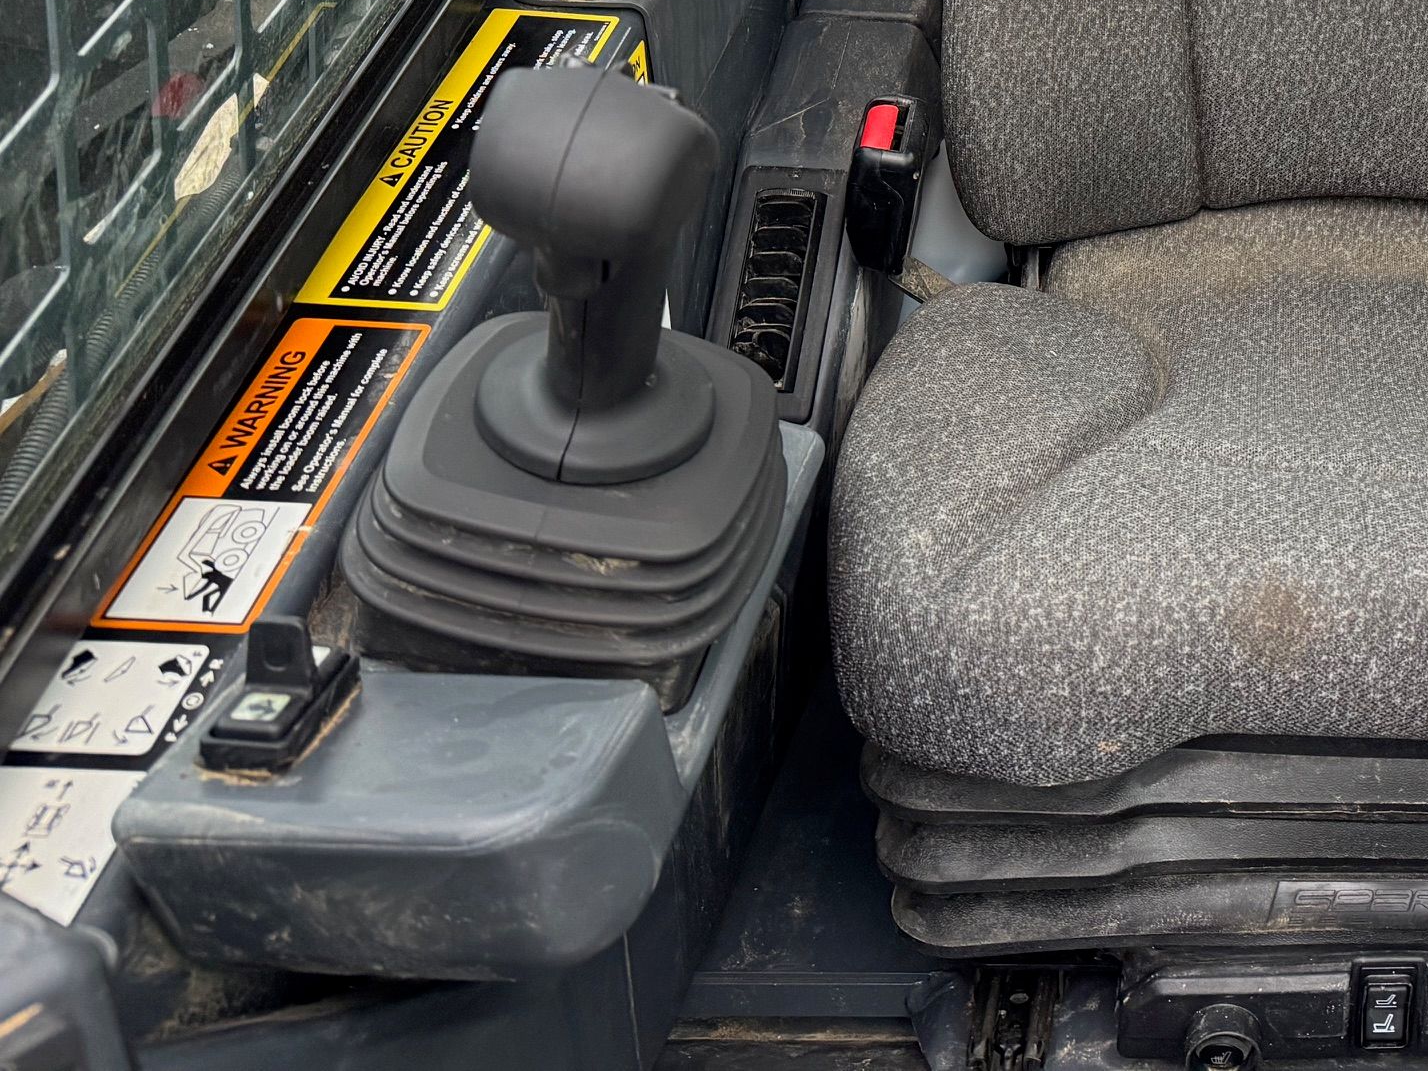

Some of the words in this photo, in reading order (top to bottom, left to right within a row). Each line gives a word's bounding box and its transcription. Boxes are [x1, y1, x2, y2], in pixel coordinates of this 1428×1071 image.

[390, 99, 454, 169] CAUTION
[455, 108, 472, 124] Keep
[467, 85, 487, 108] children
[482, 74, 495, 86] and
[490, 57, 506, 75] others
[347, 261, 369, 286] AVOID
[362, 235, 386, 262] INJURY
[383, 214, 401, 231] Read
[397, 201, 410, 214] and
[406, 165, 434, 201] understand
[359, 249, 389, 286] Operator's
[382, 225, 406, 250] Manual
[399, 203, 420, 225] before
[416, 173, 442, 204] operating
[434, 161, 448, 173] this
[373, 255, 399, 287] machine.
[392, 267, 412, 288] Know
[405, 239, 430, 268] location
[425, 225, 439, 240] and
[432, 198, 456, 226] function
[451, 190, 460, 199] of
[413, 270, 433, 289] Keep
[427, 248, 447, 270] safety
[440, 222, 462, 249] devices
[434, 271, 453, 290] Keep
[448, 244, 470, 271] screens
[465, 230, 478, 244] and
[220, 349, 307, 450] WARNING
[240, 452, 268, 490] Always
[261, 425, 286, 458] install
[278, 406, 301, 430] boom
[294, 387, 313, 409] lock
[306, 359, 332, 390] before
[255, 449, 285, 491] working
[279, 440, 293, 455] on
[287, 429, 299, 441] or
[294, 399, 320, 430] around
[312, 383, 330, 401] this
[325, 347, 352, 385] machine
[347, 331, 363, 350] with
[269, 476, 286, 492] the
[280, 446, 304, 479] loader
[297, 422, 320, 448] boom
[316, 392, 339, 423] raised.
[291, 474, 309, 492] See
[303, 428, 339, 475] Operator's
[331, 397, 354, 430] Manual
[350, 385, 363, 398] for
[360, 347, 389, 385] complete
[305, 437, 347, 493] instructions.
